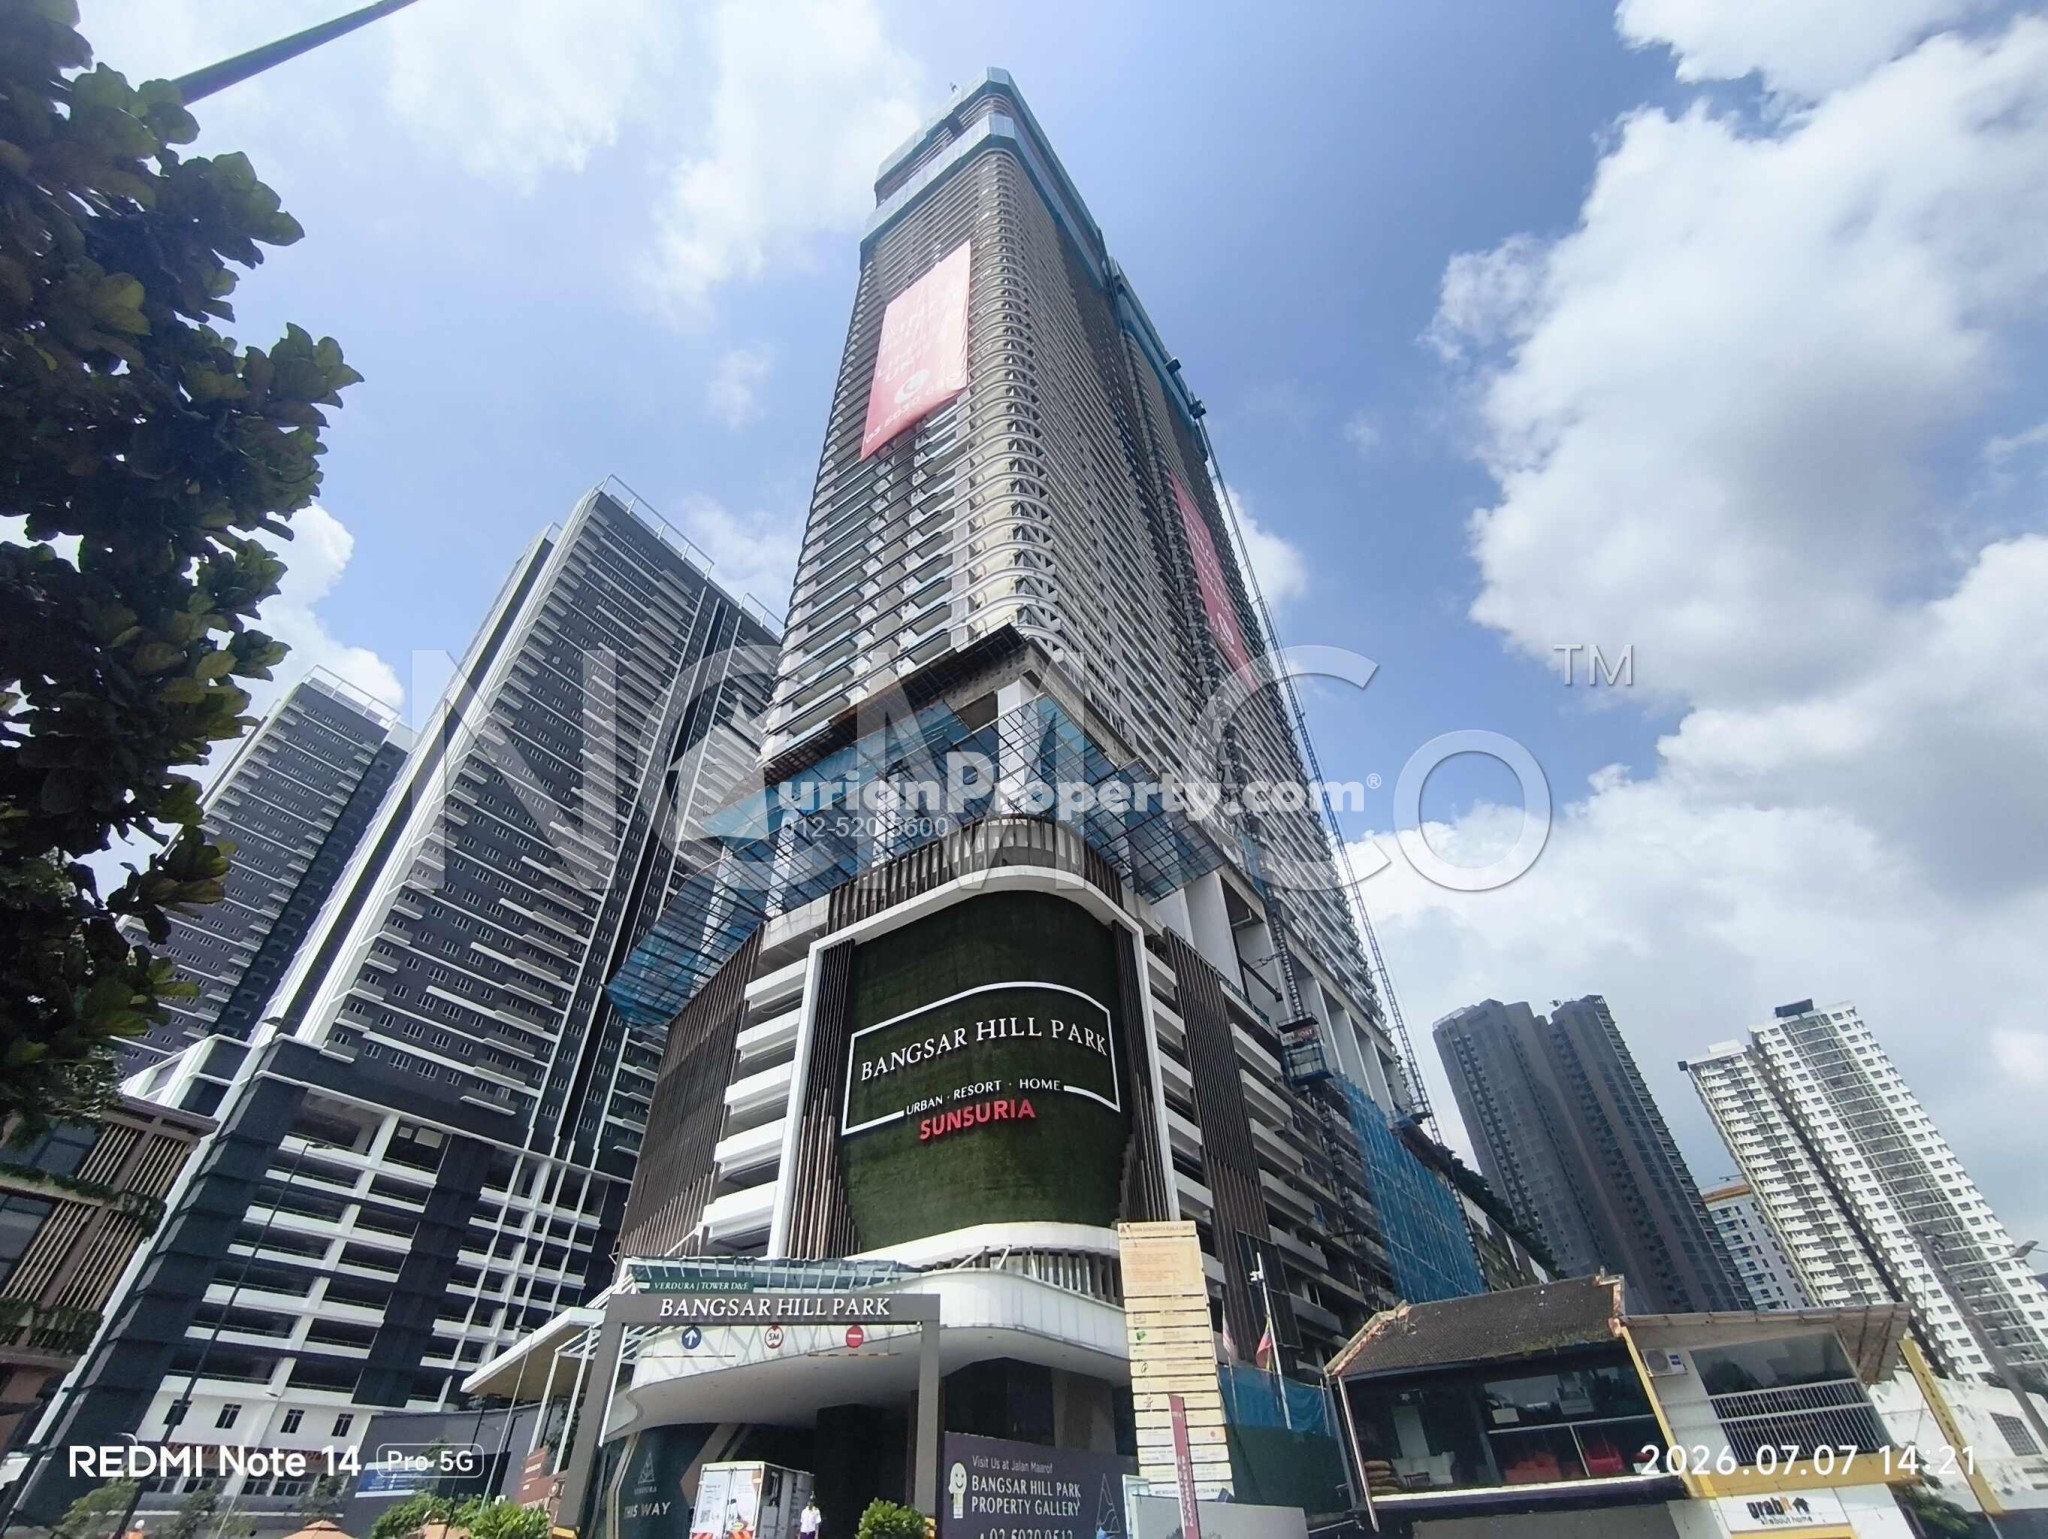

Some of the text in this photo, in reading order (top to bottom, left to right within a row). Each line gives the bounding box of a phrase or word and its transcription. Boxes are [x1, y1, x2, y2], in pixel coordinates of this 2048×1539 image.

[861, 1017, 1108, 1082] BANGSAR HILL PARK
[906, 1078, 1061, 1116] URBAN RESORT HOME
[919, 1099, 1037, 1141] SUNSURIA
[654, 1281, 695, 1290] VERDURA
[701, 1281, 730, 1290] TOWER
[659, 1297, 891, 1317] BANGSAR HILL PARK
[972, 1455, 989, 1468] Visit
[990, 1457, 1000, 1470] Us
[1001, 1459, 1010, 1471] at
[1011, 1459, 1030, 1472] Jalan
[971, 1475, 1081, 1498] BANGSAR HILL PARK
[641, 1501, 671, 1516] WAY
[971, 1496, 1081, 1517] PROPERTY GALLERY
